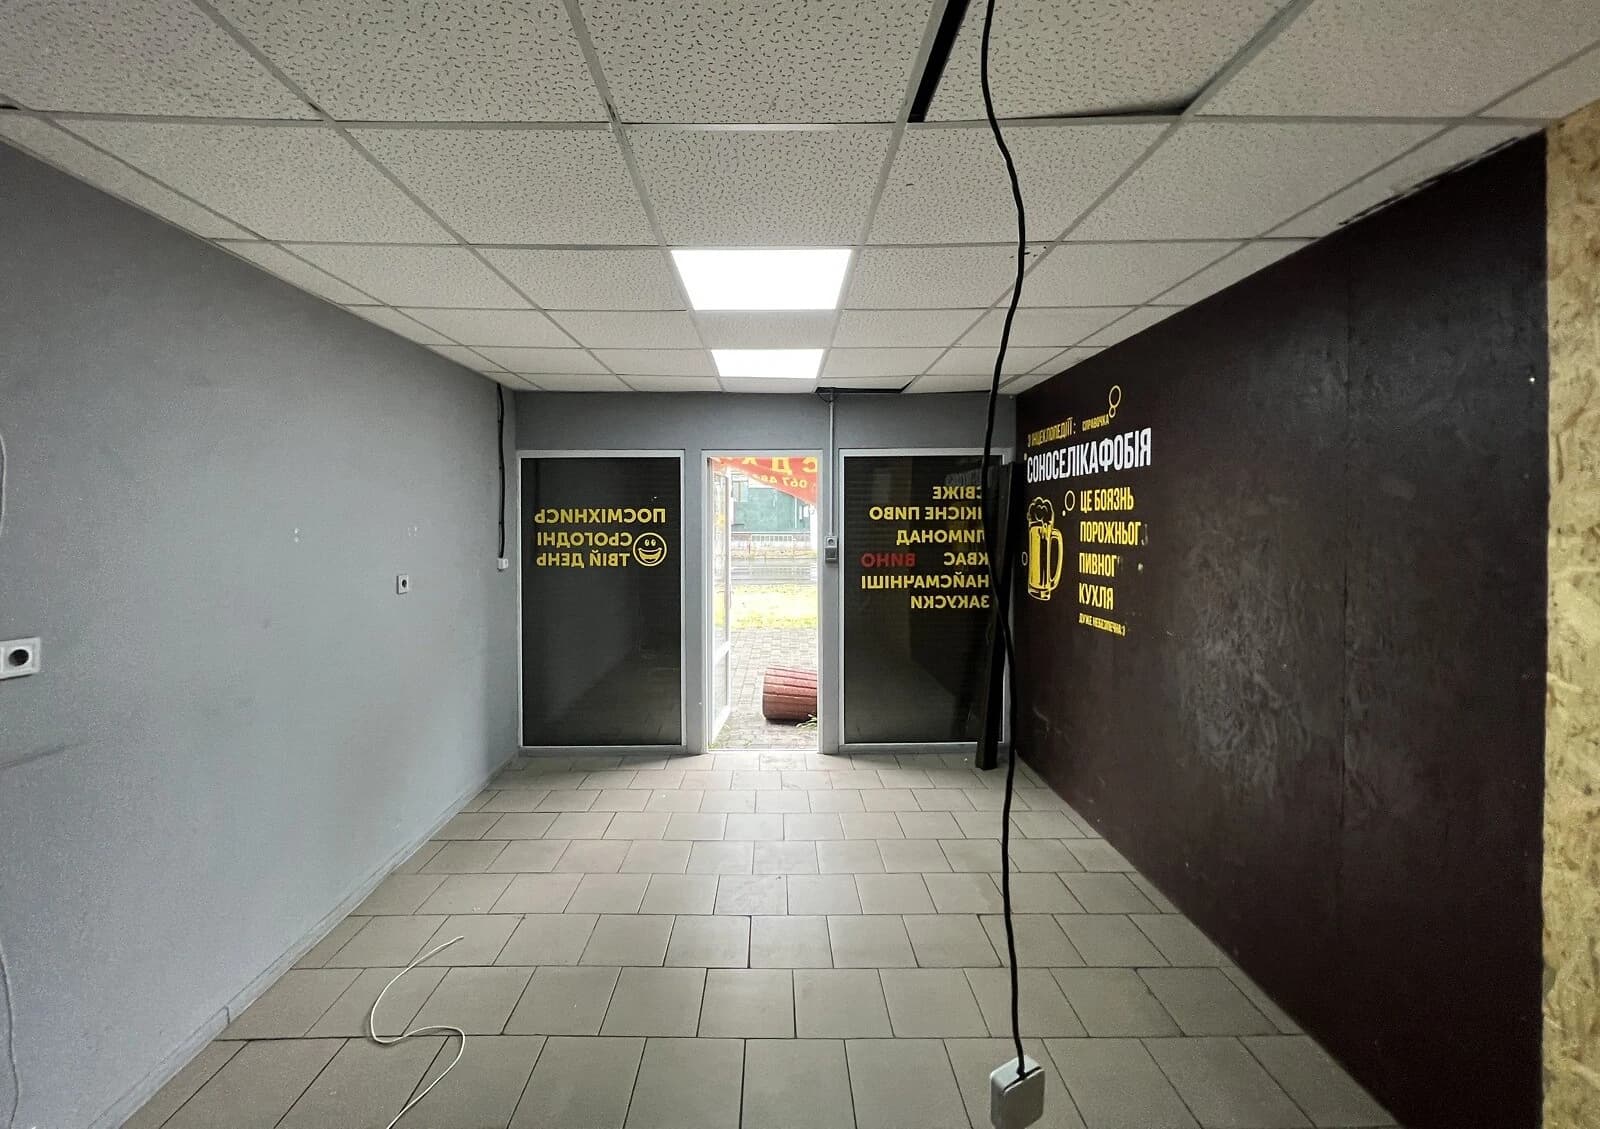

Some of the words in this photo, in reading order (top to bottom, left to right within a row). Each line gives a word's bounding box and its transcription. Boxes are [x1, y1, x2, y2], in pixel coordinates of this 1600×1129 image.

[1026, 427, 1152, 484] СОНОСЕЛІКАФОБІЯ
[1080, 490, 1093, 514] ЦЕ
[1094, 486, 1135, 512] БОЯЗНЬ
[1078, 582, 1114, 611] КУХЛЯ
